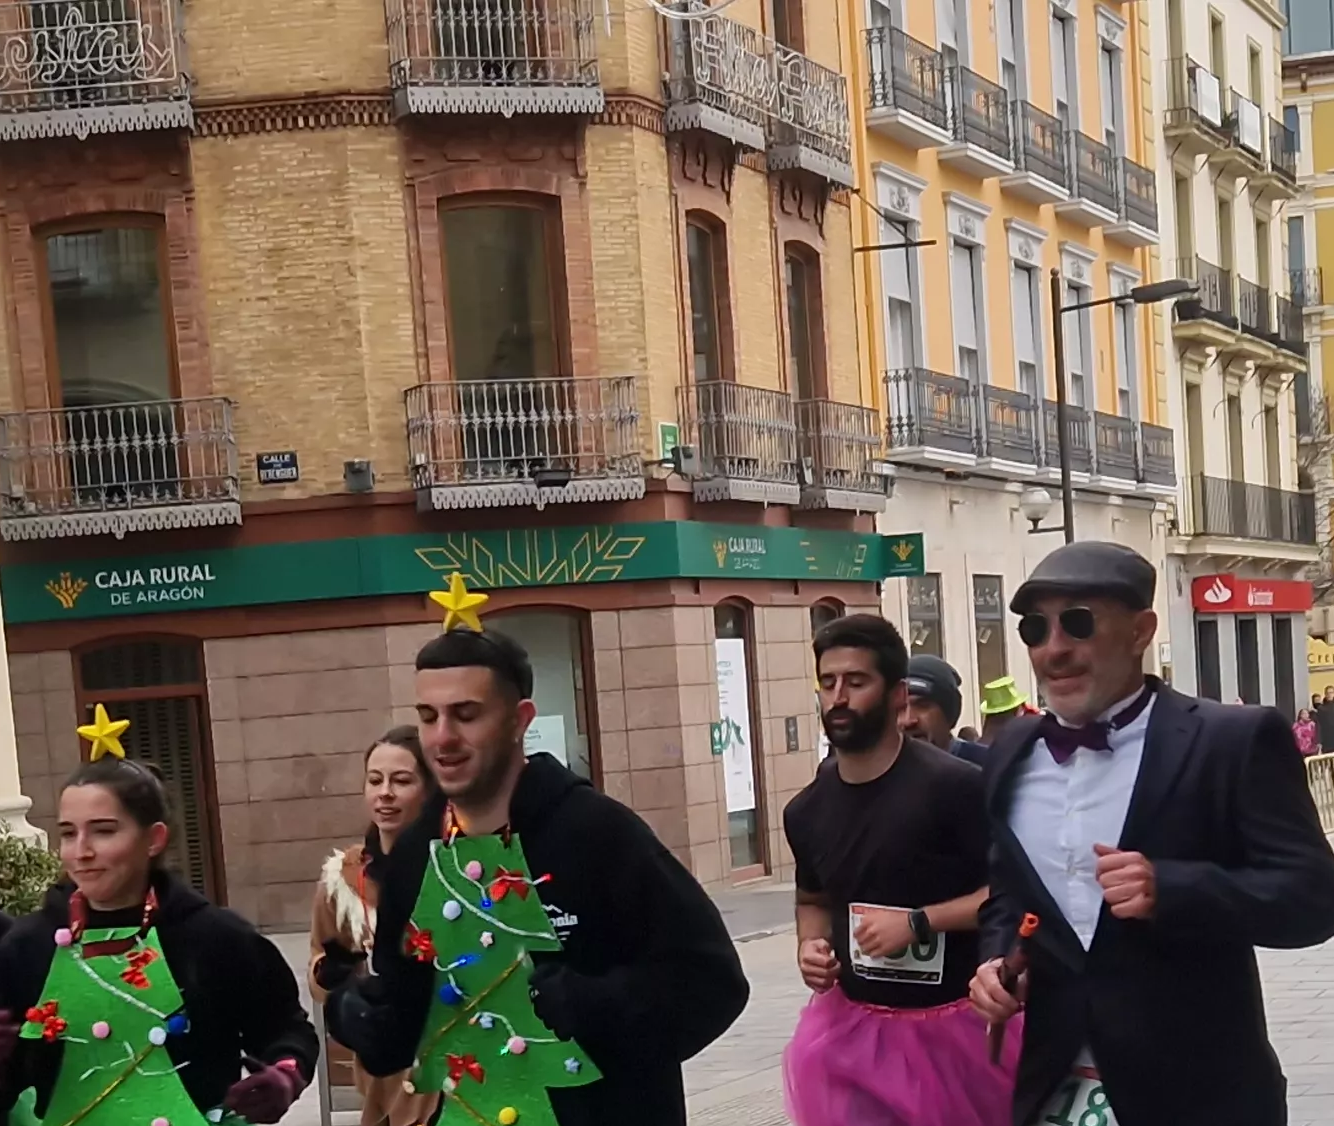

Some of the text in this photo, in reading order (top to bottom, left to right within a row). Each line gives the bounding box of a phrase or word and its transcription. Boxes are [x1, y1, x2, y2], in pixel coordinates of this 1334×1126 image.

[95, 564, 216, 589] CAJA RURAL
[110, 585, 204, 606] DE ARAGÓN
